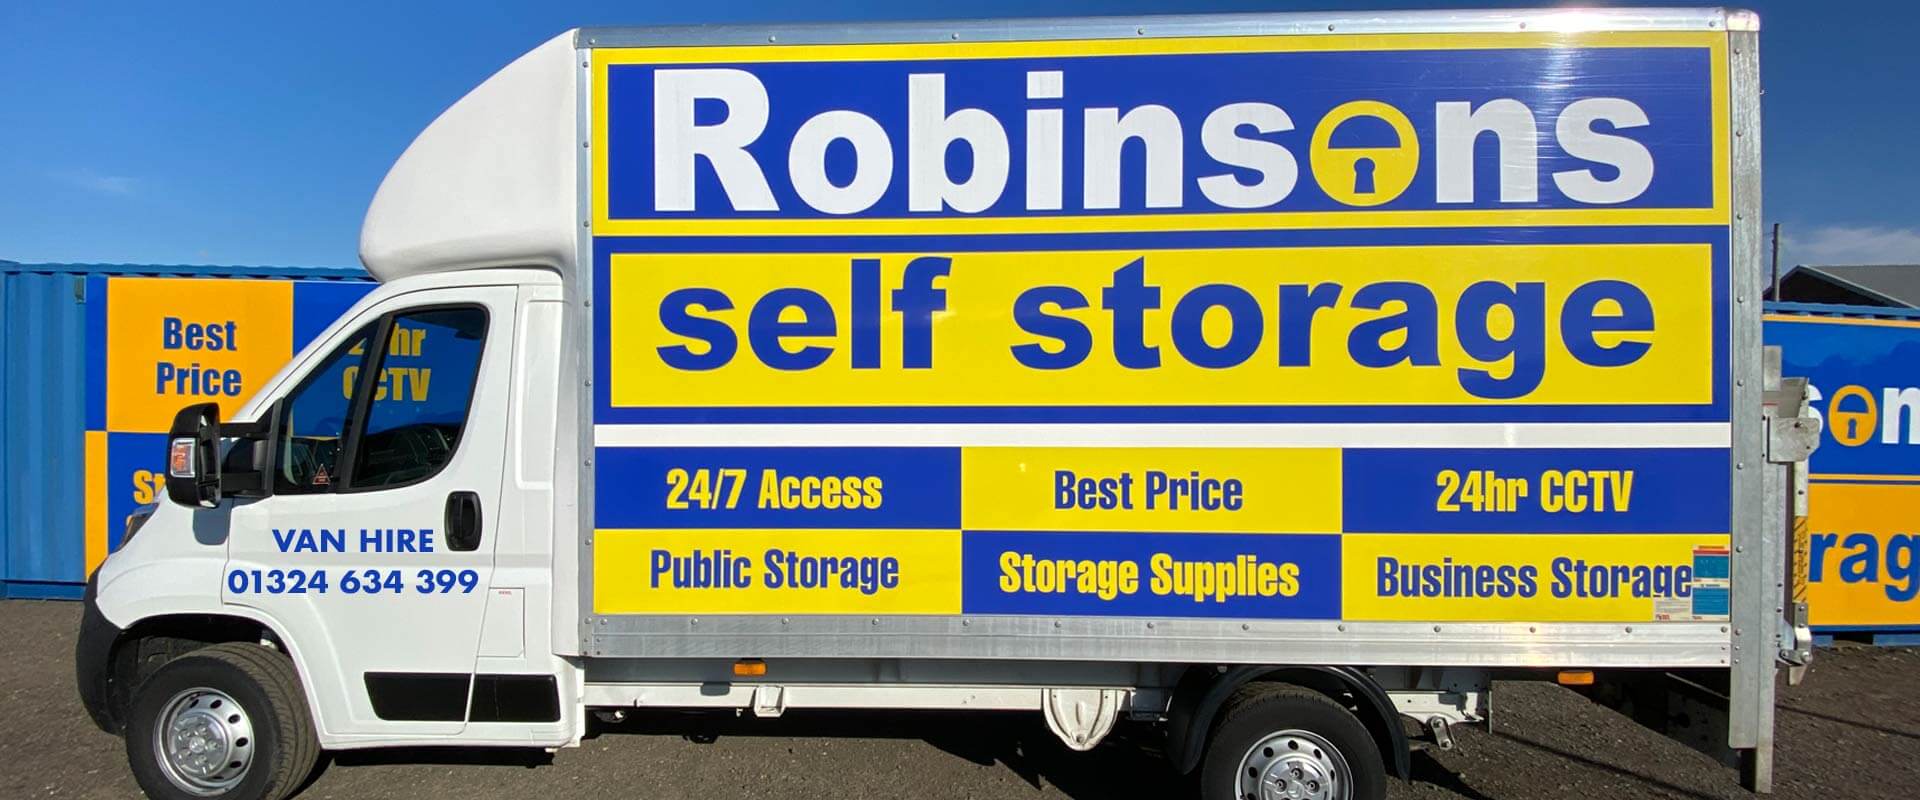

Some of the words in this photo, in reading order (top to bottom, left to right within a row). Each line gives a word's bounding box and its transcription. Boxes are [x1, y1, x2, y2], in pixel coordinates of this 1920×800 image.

[653, 69, 1656, 214] Robinsons
[163, 317, 237, 351] Best
[656, 256, 952, 371] self
[1010, 255, 1656, 400] storage
[156, 362, 242, 397] Price
[666, 468, 747, 510] 24/7
[758, 468, 883, 510] Access
[1055, 470, 1133, 510] Best
[1146, 471, 1243, 511] Price
[1436, 469, 1528, 512] 24hr
[1541, 469, 1634, 512] CCTV
[272, 528, 348, 554] VAN
[359, 528, 434, 554] HIRE
[227, 568, 329, 595] 01324
[340, 568, 403, 595] 634
[415, 568, 479, 595] 399
[650, 549, 751, 588] Public
[764, 549, 899, 594] Storage
[999, 550, 1139, 601] Storage
[1150, 552, 1300, 603] Supplies
[1377, 556, 1538, 598] Business
[1551, 556, 1692, 598] Storage
